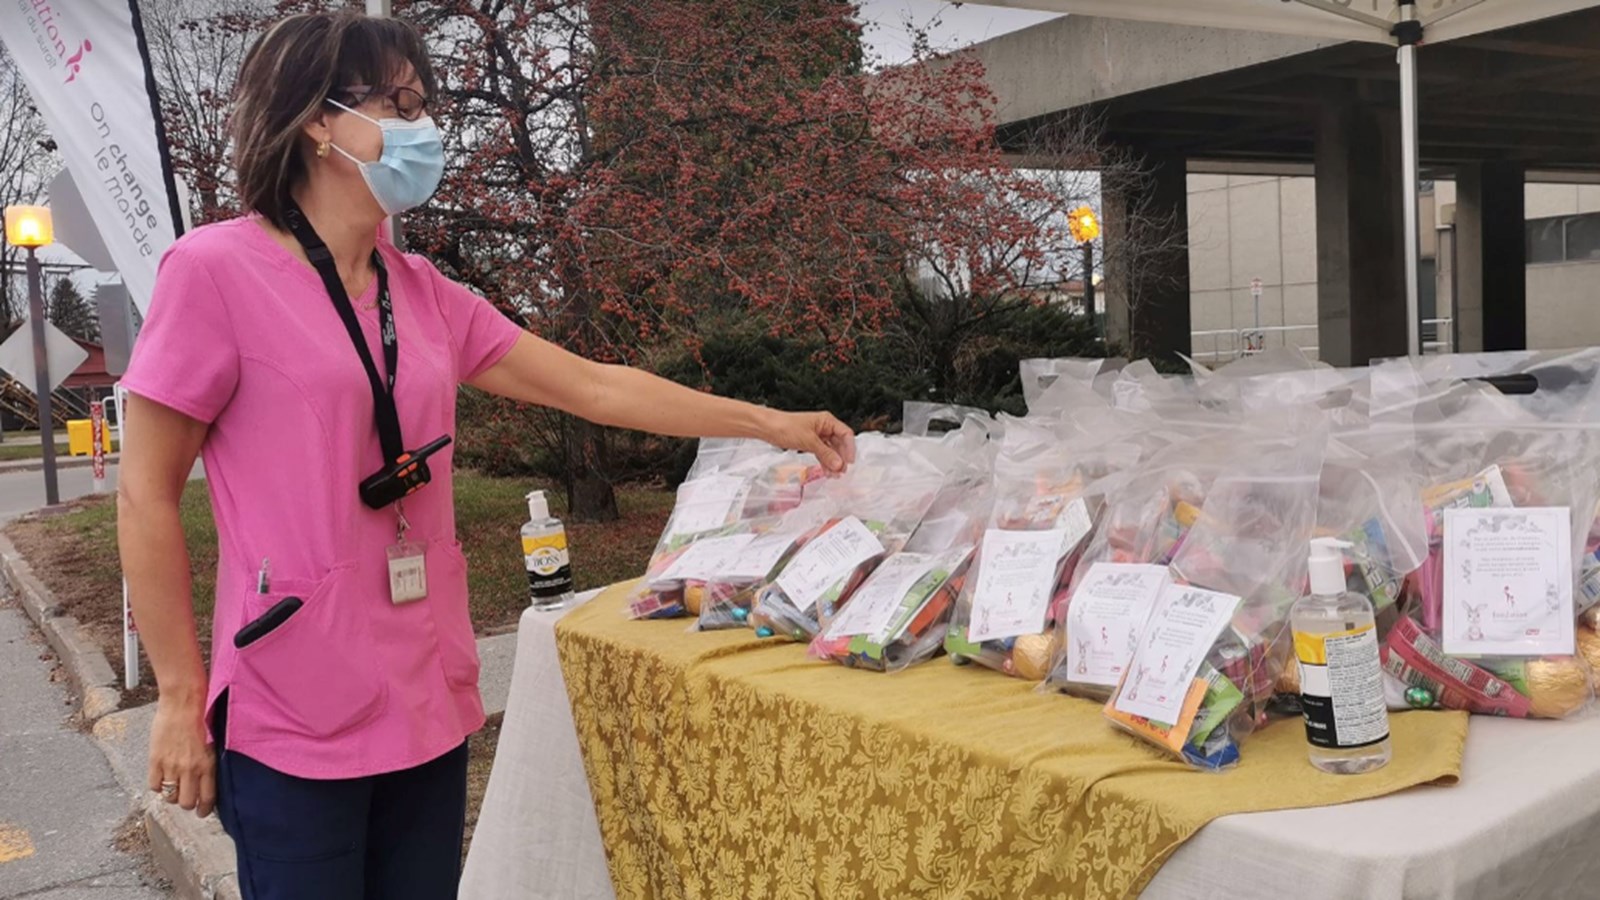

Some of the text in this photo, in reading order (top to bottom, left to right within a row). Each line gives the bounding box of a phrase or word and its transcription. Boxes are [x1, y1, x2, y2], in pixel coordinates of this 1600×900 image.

[91, 102, 157, 229] On change
[94, 147, 152, 257] le monde
